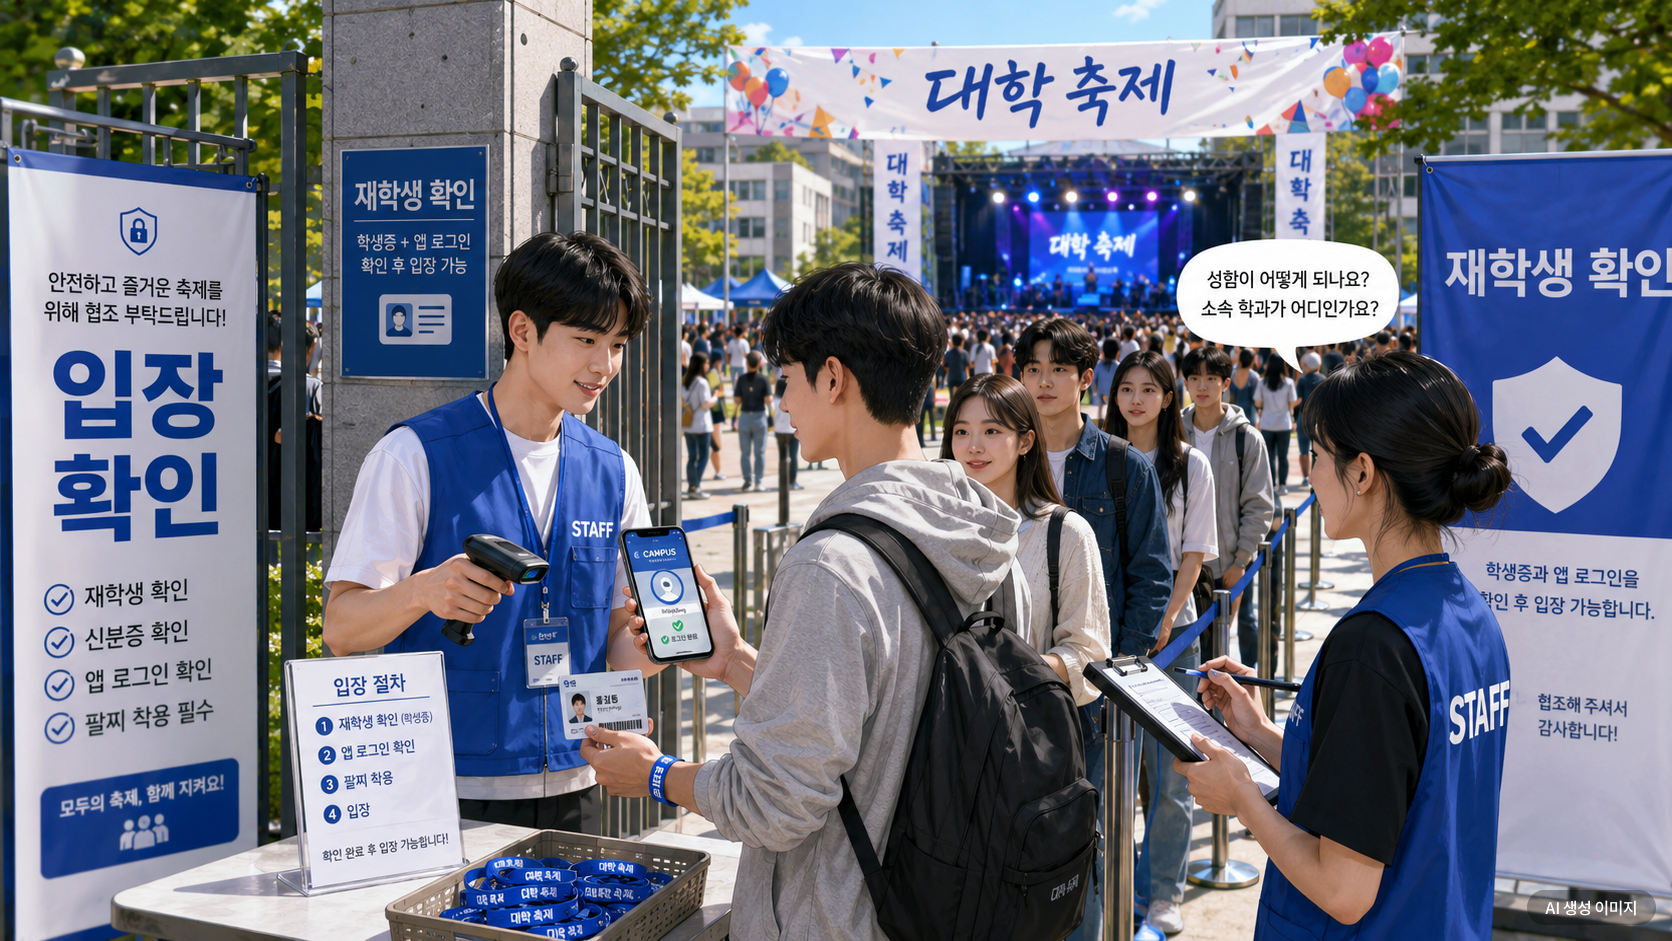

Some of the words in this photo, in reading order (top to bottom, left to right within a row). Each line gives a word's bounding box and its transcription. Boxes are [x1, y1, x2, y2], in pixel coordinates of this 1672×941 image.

[925, 59, 1054, 129] 대학
[1066, 55, 1176, 126] 축제
[354, 179, 422, 211] 재학생
[430, 179, 474, 210] 확인
[357, 234, 396, 251] 학생증
[414, 233, 427, 250] 앱
[431, 233, 470, 250] 로그인
[1049, 232, 1091, 260] 대학
[1093, 230, 1136, 261] 축제
[361, 257, 387, 274] 확인
[392, 257, 405, 274] 후
[410, 257, 436, 274] 입장
[441, 257, 467, 274] 가능
[1445, 247, 1573, 298] 재학생
[1589, 247, 1672, 298] 확인
[49, 272, 117, 294] 안전하고
[122, 276, 171, 298] 즐거운
[176, 279, 223, 300] 축제를
[44, 300, 79, 323] 위해
[85, 302, 119, 324] 협조
[124, 304, 226, 327] 부탁드립니다!
[53, 350, 223, 439] 입장
[53, 452, 219, 542] 확인
[572, 520, 614, 538] STAFF
[1486, 562, 1548, 583] 학생증과
[1554, 566, 1568, 584] 앱
[1574, 567, 1639, 588] 로그인을
[84, 582, 143, 608] 재학생
[150, 578, 188, 603] 확인
[1514, 594, 1529, 612] 후
[1534, 596, 1565, 614] 입장
[1570, 598, 1655, 620] 가능합니다.
[85, 624, 144, 651] 신분증
[151, 620, 188, 644] 확인
[534, 654, 562, 666] STAFF
[85, 670, 104, 694] 앱
[112, 662, 168, 688] 로그인
[176, 658, 212, 682] 확인
[334, 676, 367, 697] 입장
[373, 673, 406, 694] 절차
[85, 709, 125, 736] 팔찌
[132, 704, 170, 729] 착용
[178, 699, 214, 724] 필수
[1449, 680, 1510, 745] STAFF
[1538, 694, 1580, 713] 협조해
[1584, 698, 1628, 717] 주셔서
[376, 712, 398, 727] 확인
[1538, 720, 1618, 742] 감사합니다!
[341, 746, 353, 760] 앱
[356, 742, 390, 758] 로그인
[393, 739, 415, 754] 확인
[344, 774, 368, 790] 팔찌
[371, 771, 393, 785] 착용
[60, 794, 104, 818] 모두의
[109, 788, 142, 809] 축제,
[146, 782, 174, 803] 함께
[179, 774, 224, 797] 지켜요!
[347, 802, 370, 819] 입장
[345, 846, 364, 859] 완료
[368, 843, 376, 855] 후
[380, 841, 397, 854] 입장
[401, 833, 449, 850] 가능합니다!
